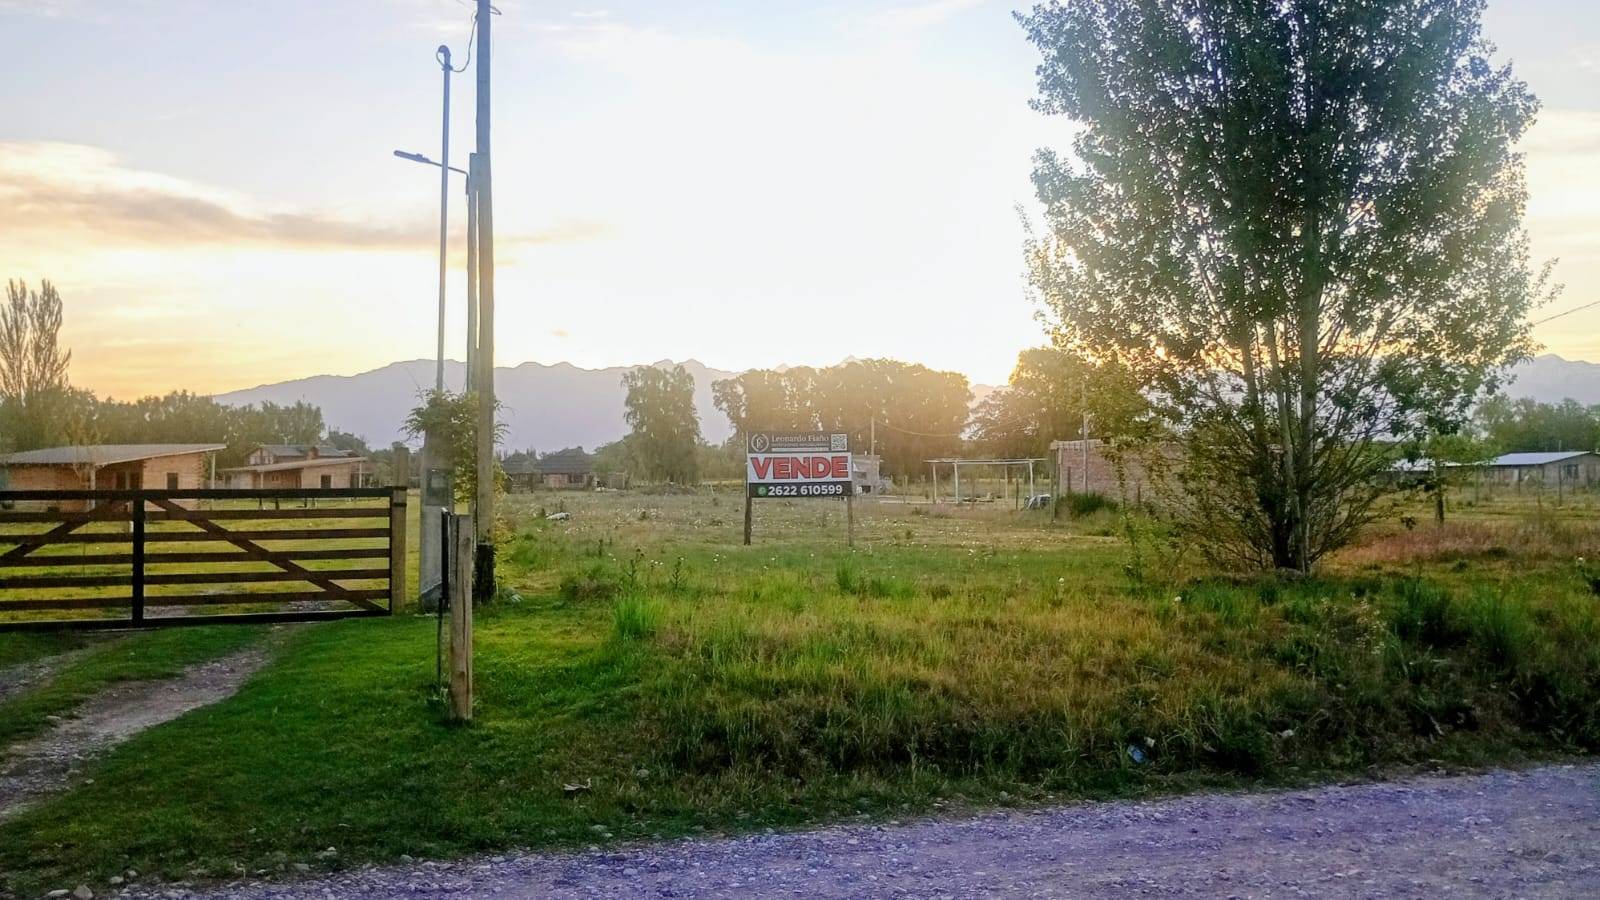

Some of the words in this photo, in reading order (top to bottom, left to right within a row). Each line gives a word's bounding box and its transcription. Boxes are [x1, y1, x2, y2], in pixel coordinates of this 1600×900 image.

[771, 433, 806, 442] Leonardo
[751, 456, 848, 479] VENDE
[768, 486, 797, 495] 2622
[800, 485, 843, 495] 610599
